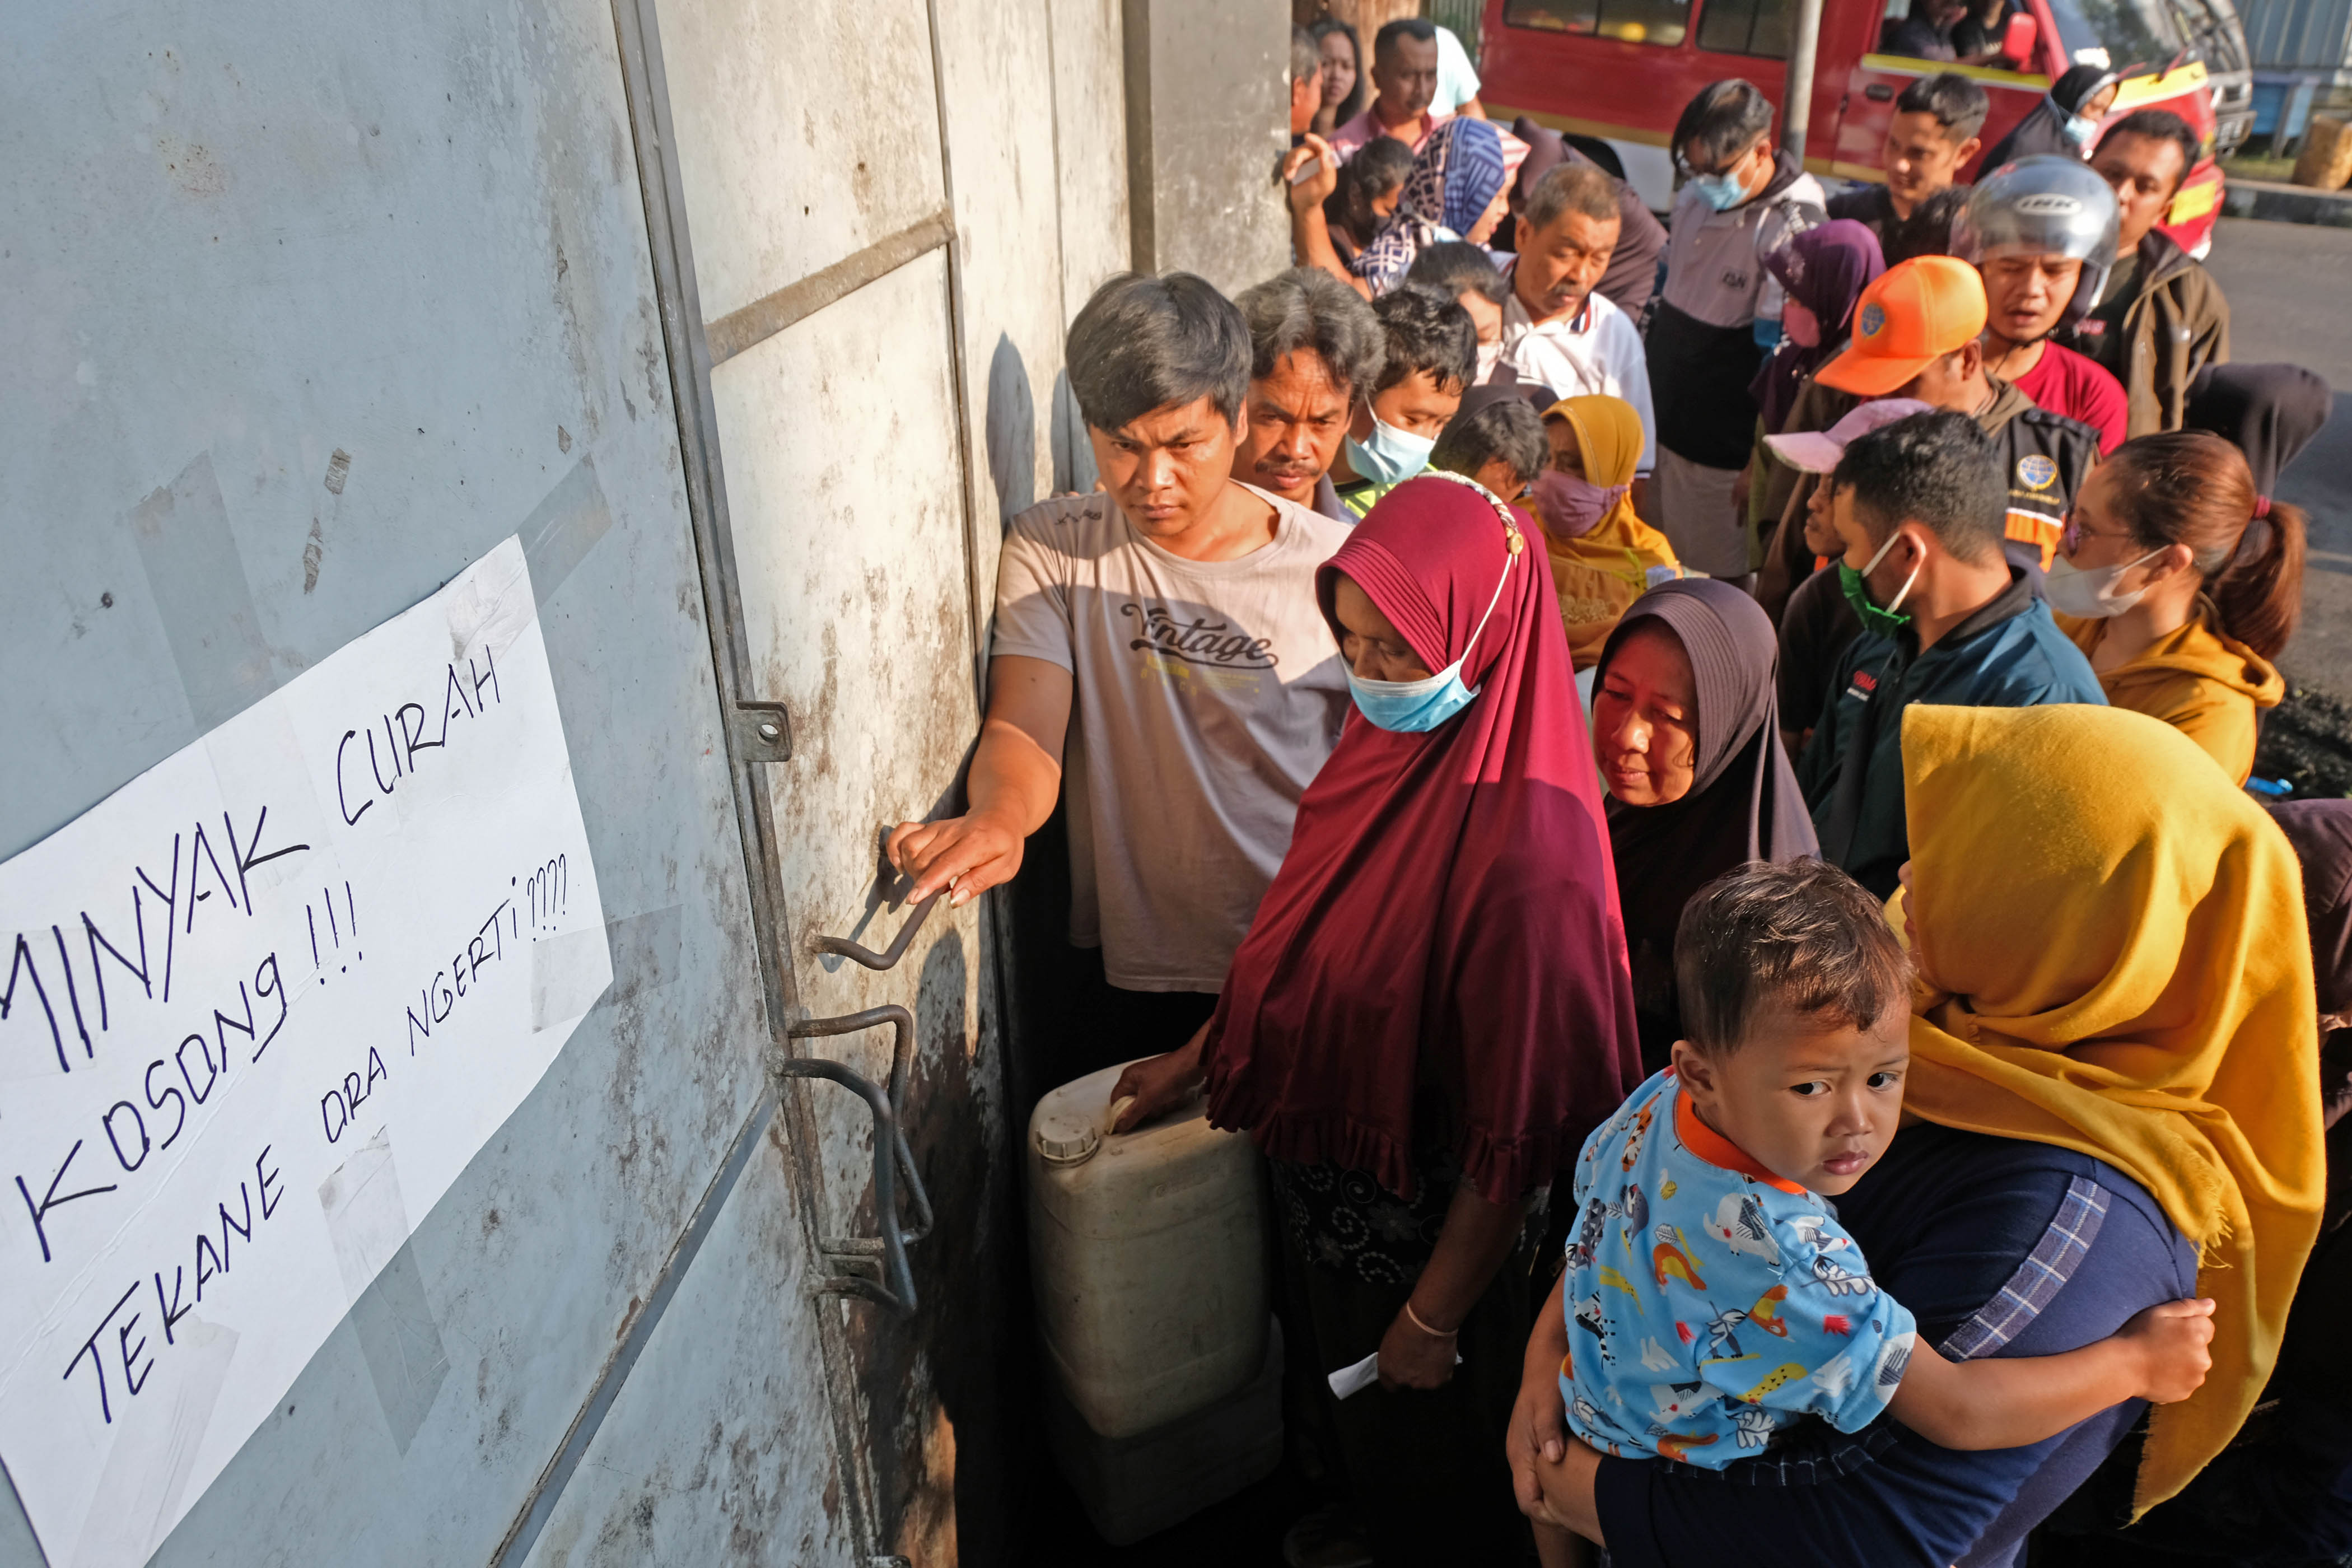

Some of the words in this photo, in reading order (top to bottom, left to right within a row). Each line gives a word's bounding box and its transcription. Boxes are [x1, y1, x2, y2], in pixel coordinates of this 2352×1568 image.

[337, 645, 500, 826] CURAH
[63, 1144, 284, 1424] TEKANE
[321, 1046, 387, 1144] ORA
